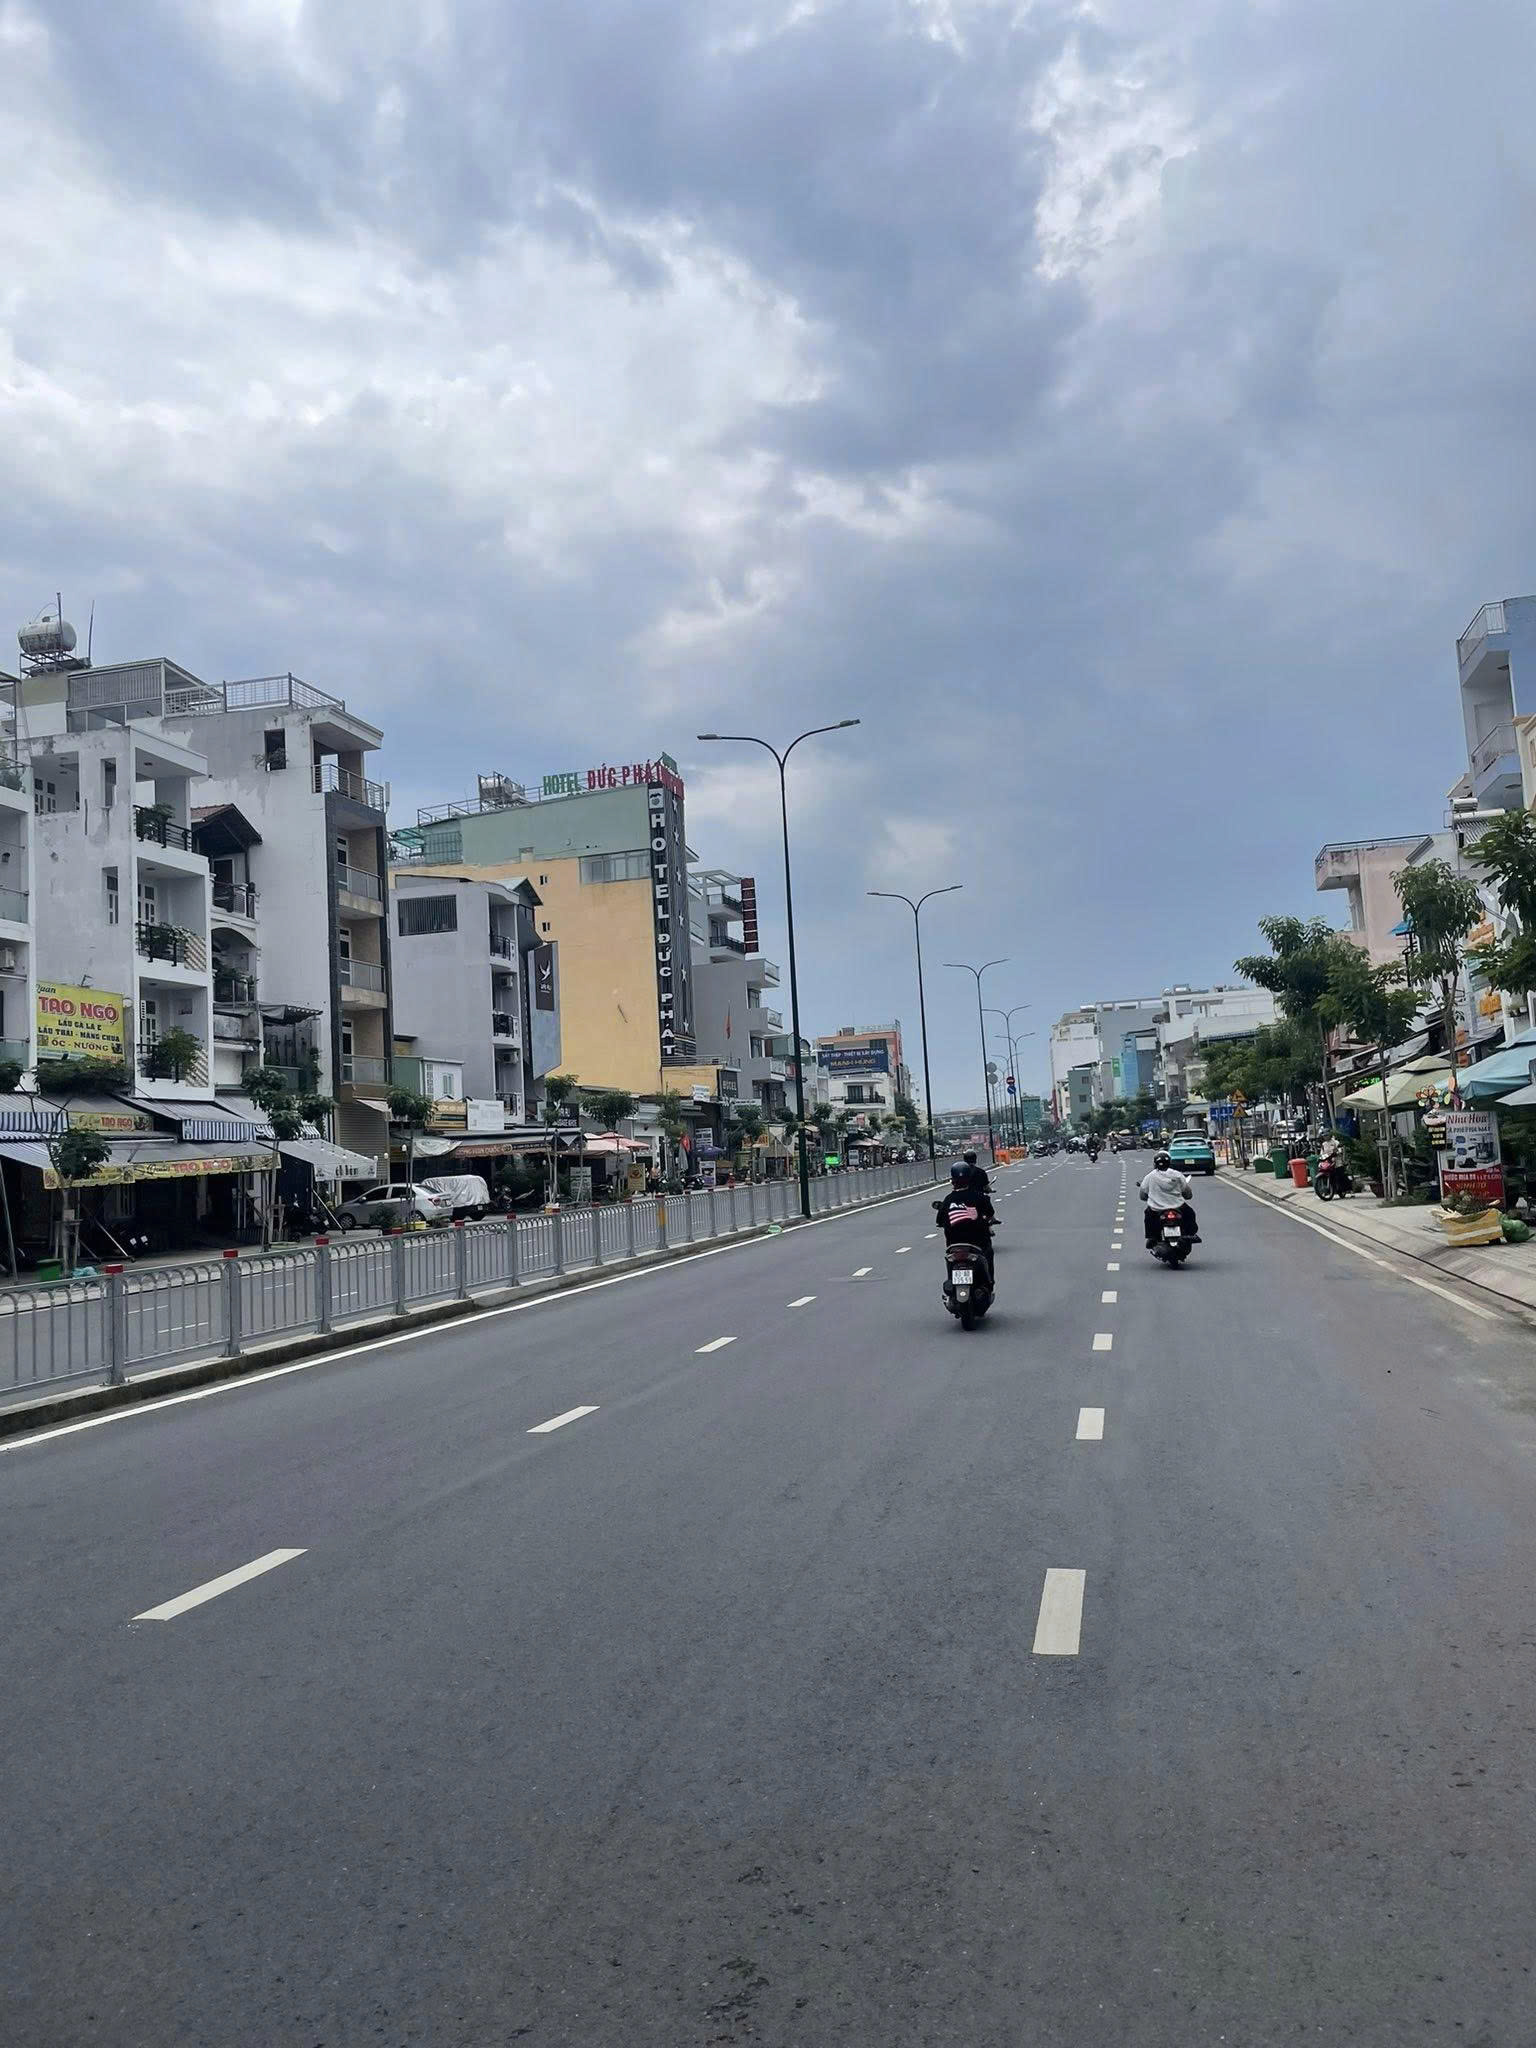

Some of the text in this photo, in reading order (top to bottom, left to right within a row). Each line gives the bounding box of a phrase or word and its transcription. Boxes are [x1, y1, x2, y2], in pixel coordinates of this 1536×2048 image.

[543, 772, 581, 796] HOTEL
[587, 763, 617, 790] ĐỨC
[651, 813, 676, 1055] HOTEL ĐỨC PHÁT
